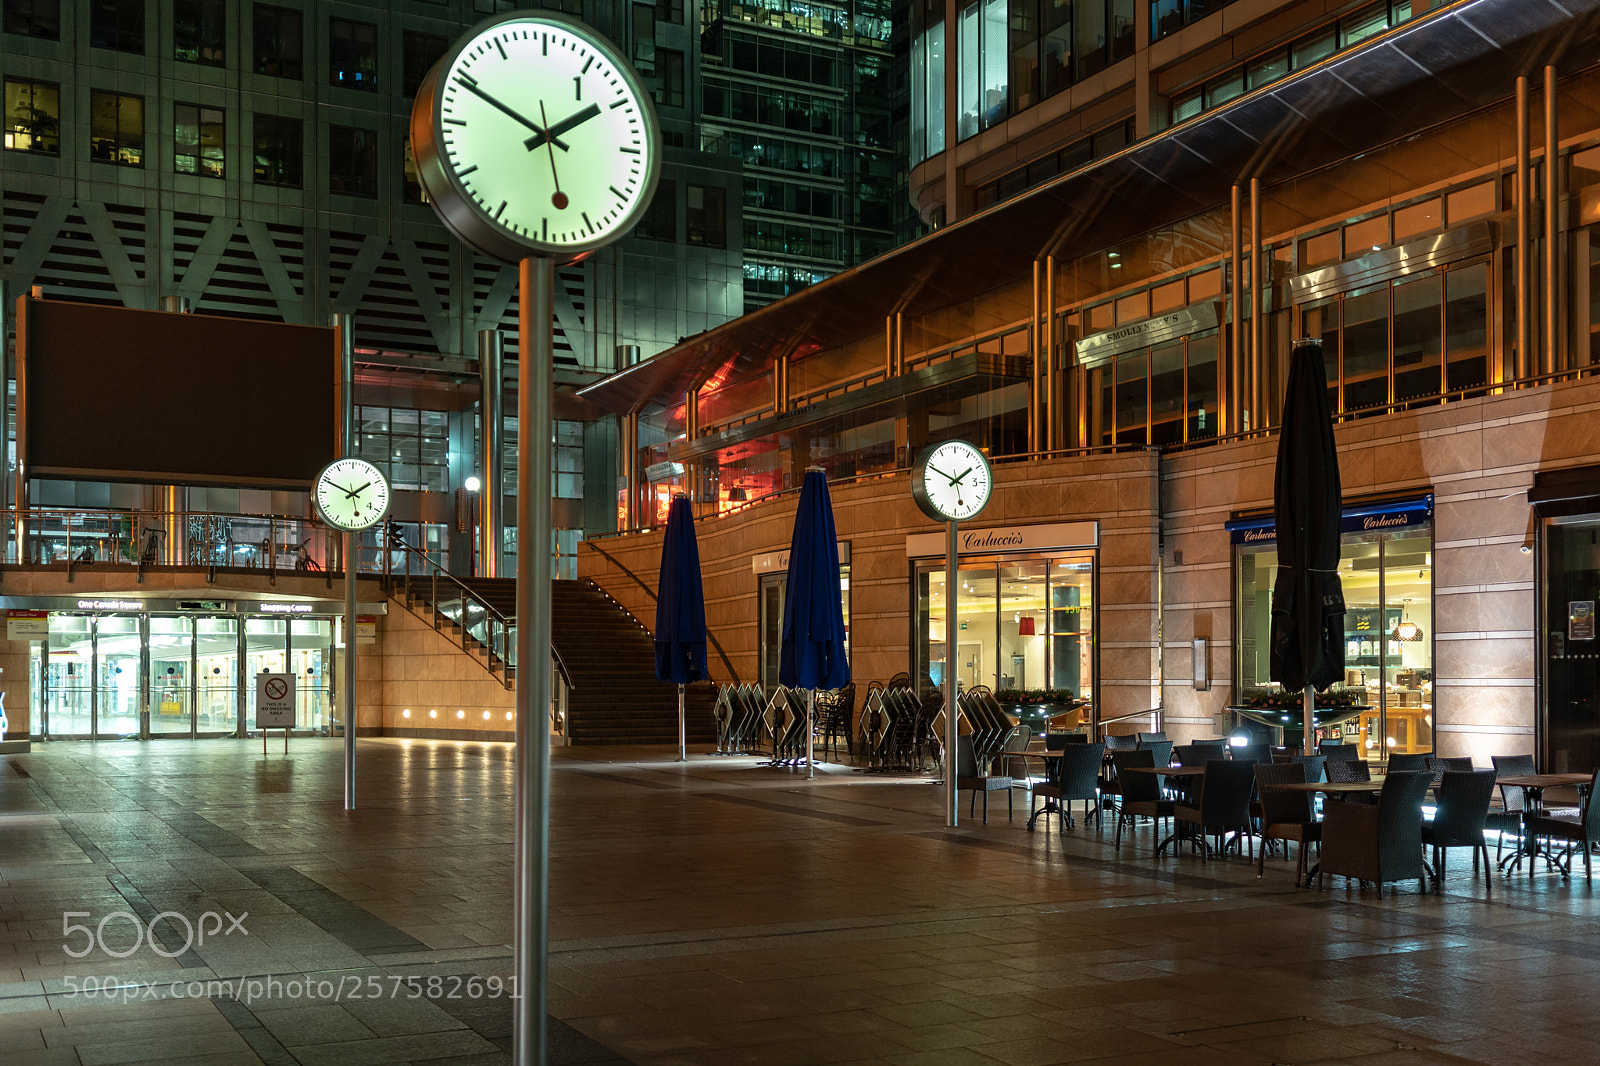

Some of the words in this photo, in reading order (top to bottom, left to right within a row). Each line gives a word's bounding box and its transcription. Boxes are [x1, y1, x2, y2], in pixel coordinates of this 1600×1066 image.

[573, 75, 581, 101] 1
[972, 477, 978, 487] 3
[366, 502, 372, 510] 4
[1363, 513, 1408, 530] Carluccio's
[963, 531, 1023, 549] Carluccio's
[1244, 528, 1277, 543] Carlucci
[78, 600, 93, 609] One
[94, 600, 119, 610] Canada
[119, 600, 143, 610] Square
[260, 603, 290, 612] Shopping
